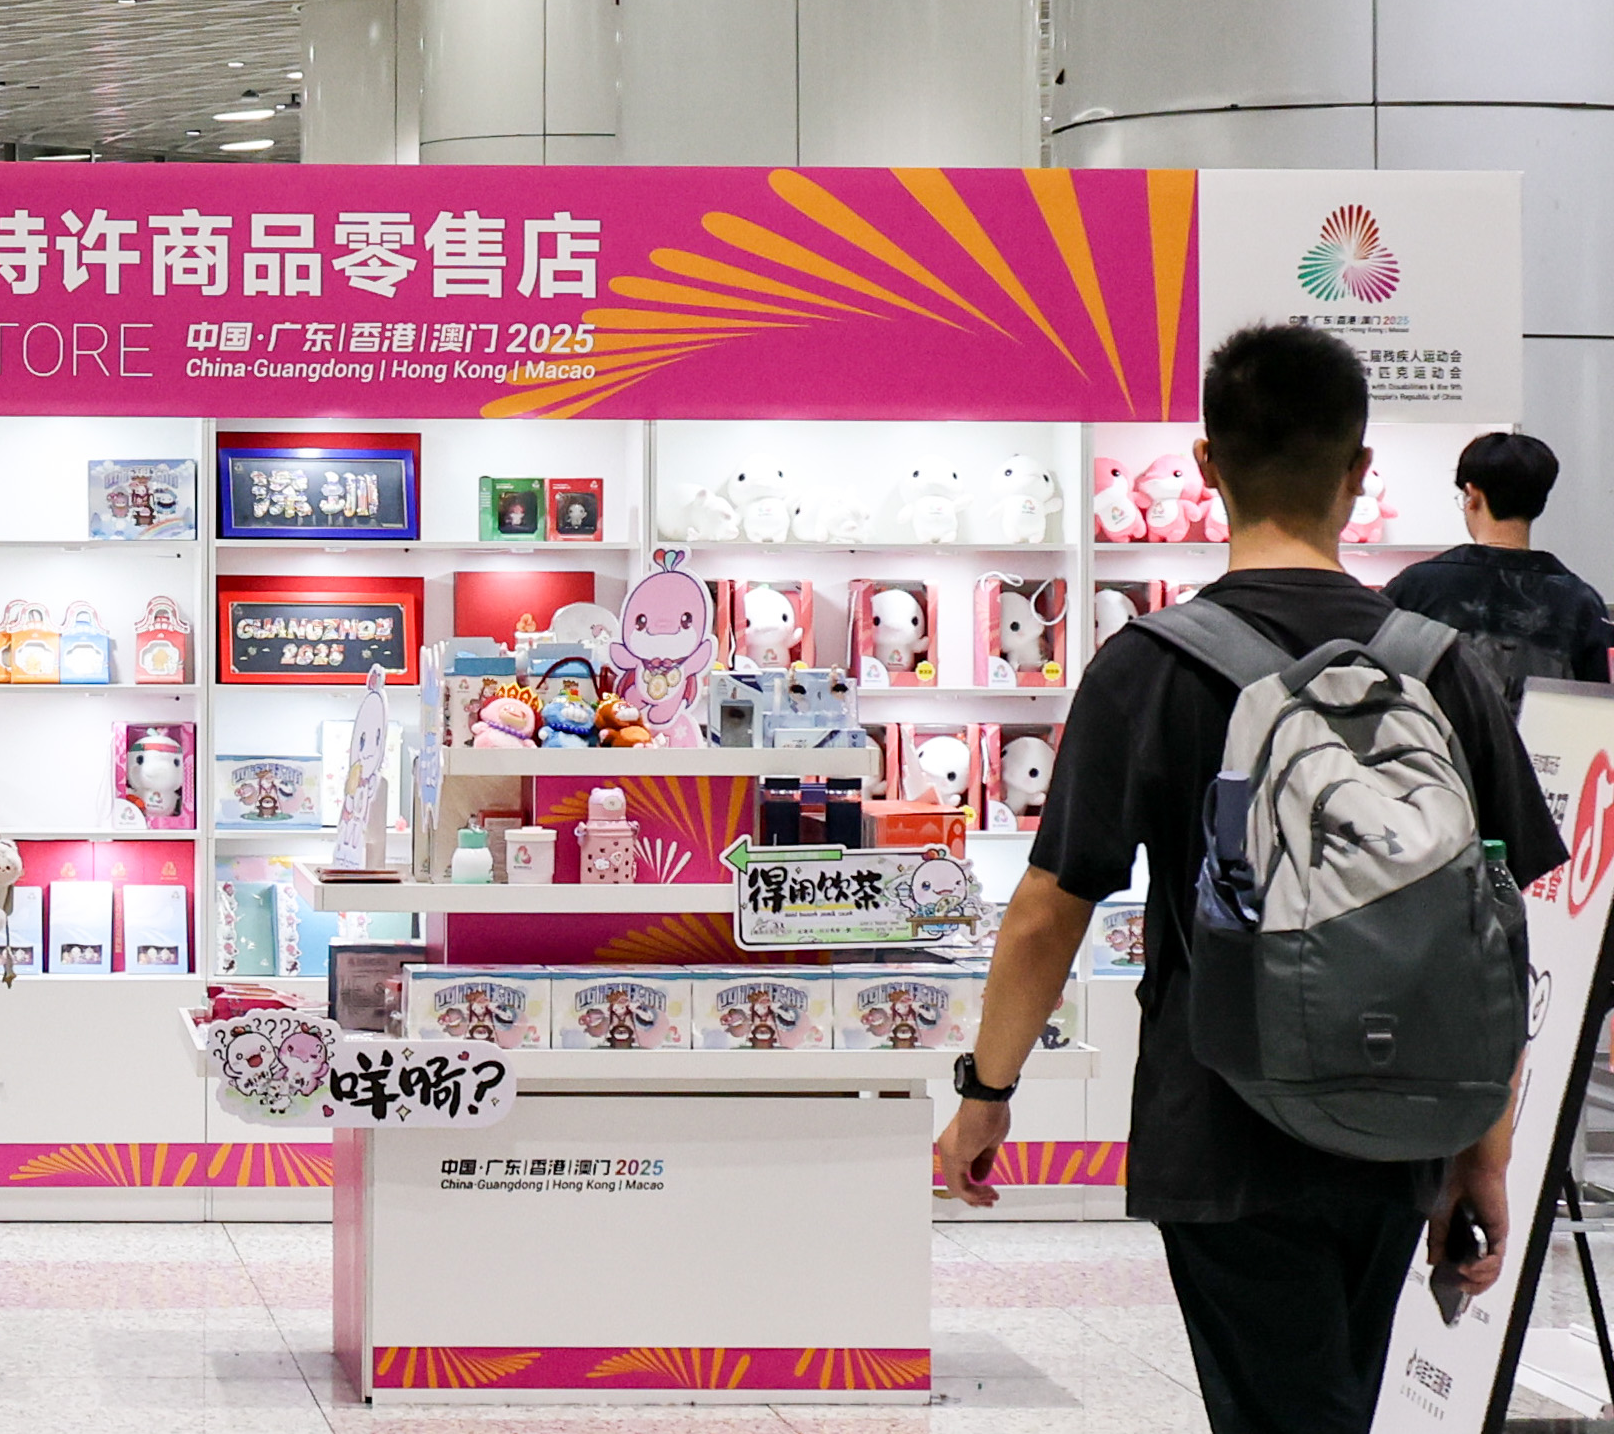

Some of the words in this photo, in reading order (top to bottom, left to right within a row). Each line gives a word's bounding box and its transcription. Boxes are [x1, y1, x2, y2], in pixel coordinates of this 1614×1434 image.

[507, 323, 596, 354] 2025
[391, 359, 447, 384] Hong
[453, 360, 507, 384] Kong
[524, 361, 596, 380] Macao
[236, 617, 393, 641] GUANGZHOU
[280, 643, 346, 666] 2025
[748, 865, 883, 914] 得闲饮茶
[615, 1159, 664, 1176] 2025
[553, 1180, 583, 1192] Hong
[587, 1180, 616, 1193] Kong
[625, 1180, 665, 1191] Macao
